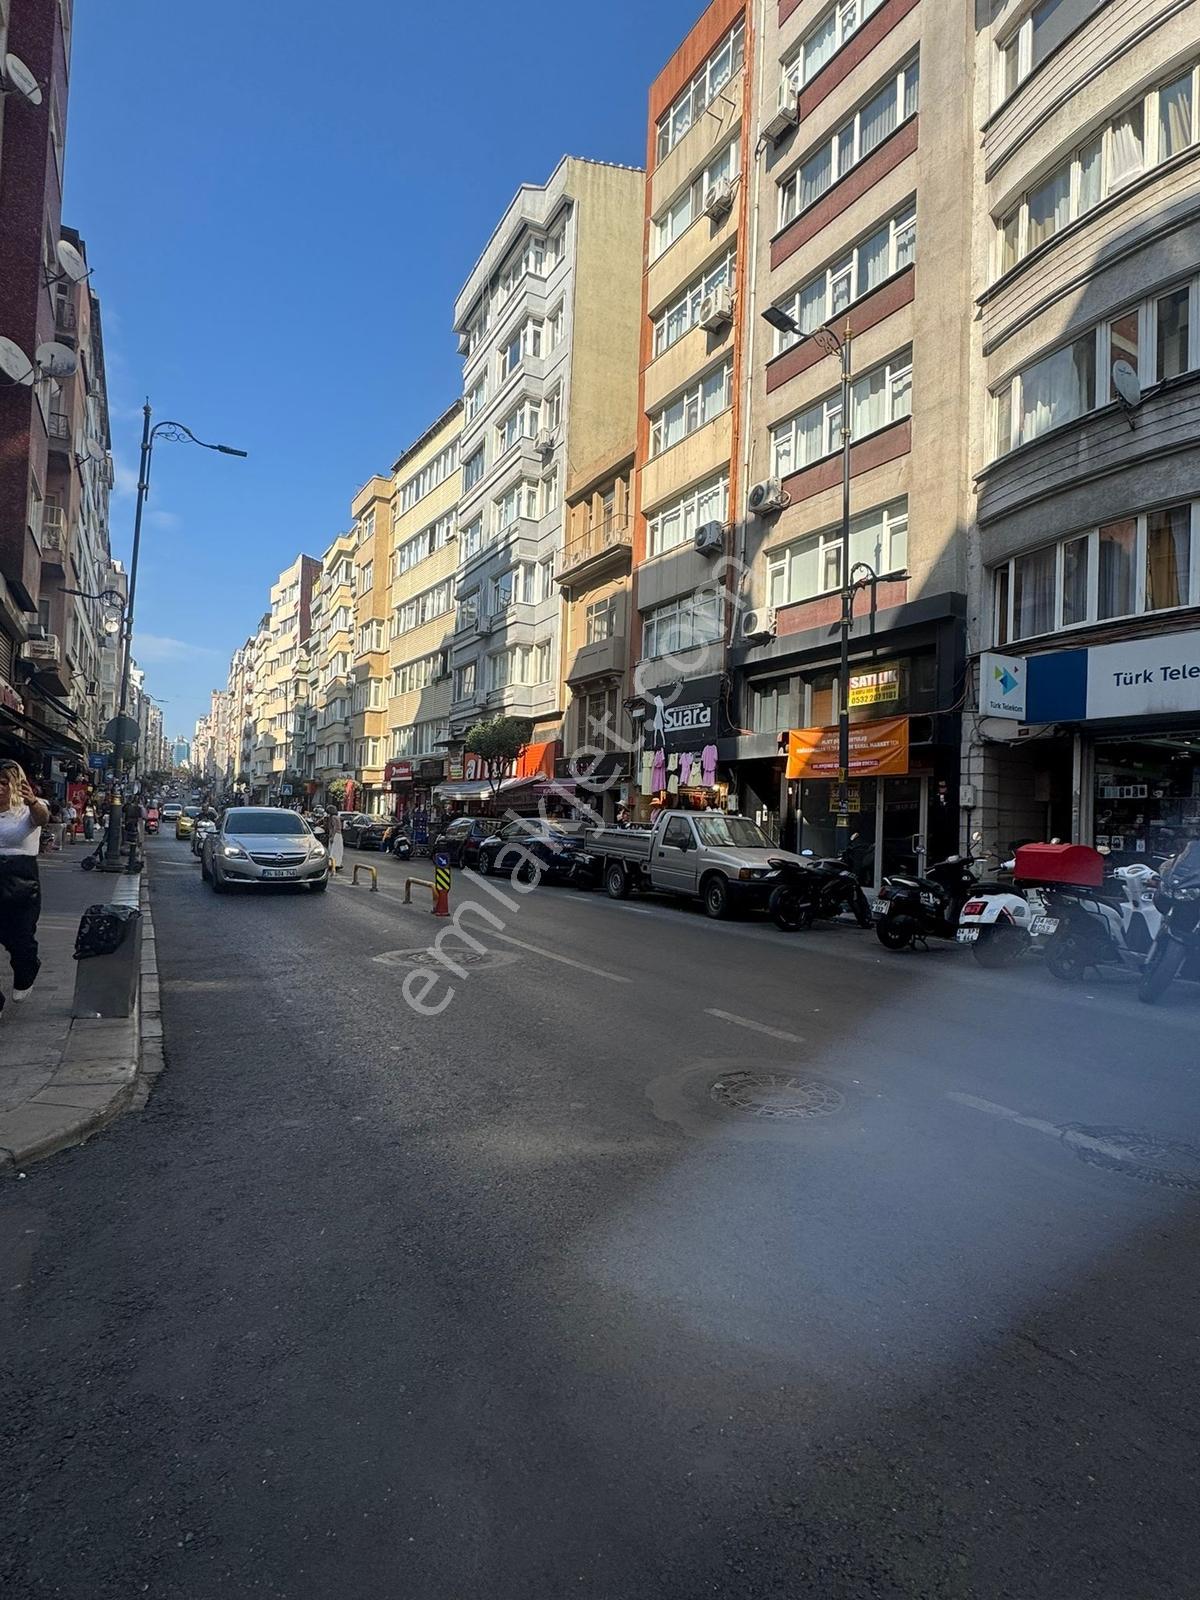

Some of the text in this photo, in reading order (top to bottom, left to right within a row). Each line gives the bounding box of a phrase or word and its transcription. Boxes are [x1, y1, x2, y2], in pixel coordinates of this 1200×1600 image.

[850, 670, 897, 689] SATILIK
[1113, 664, 1200, 687] Türk Tele
[990, 701, 1023, 712] Türk Telekom
